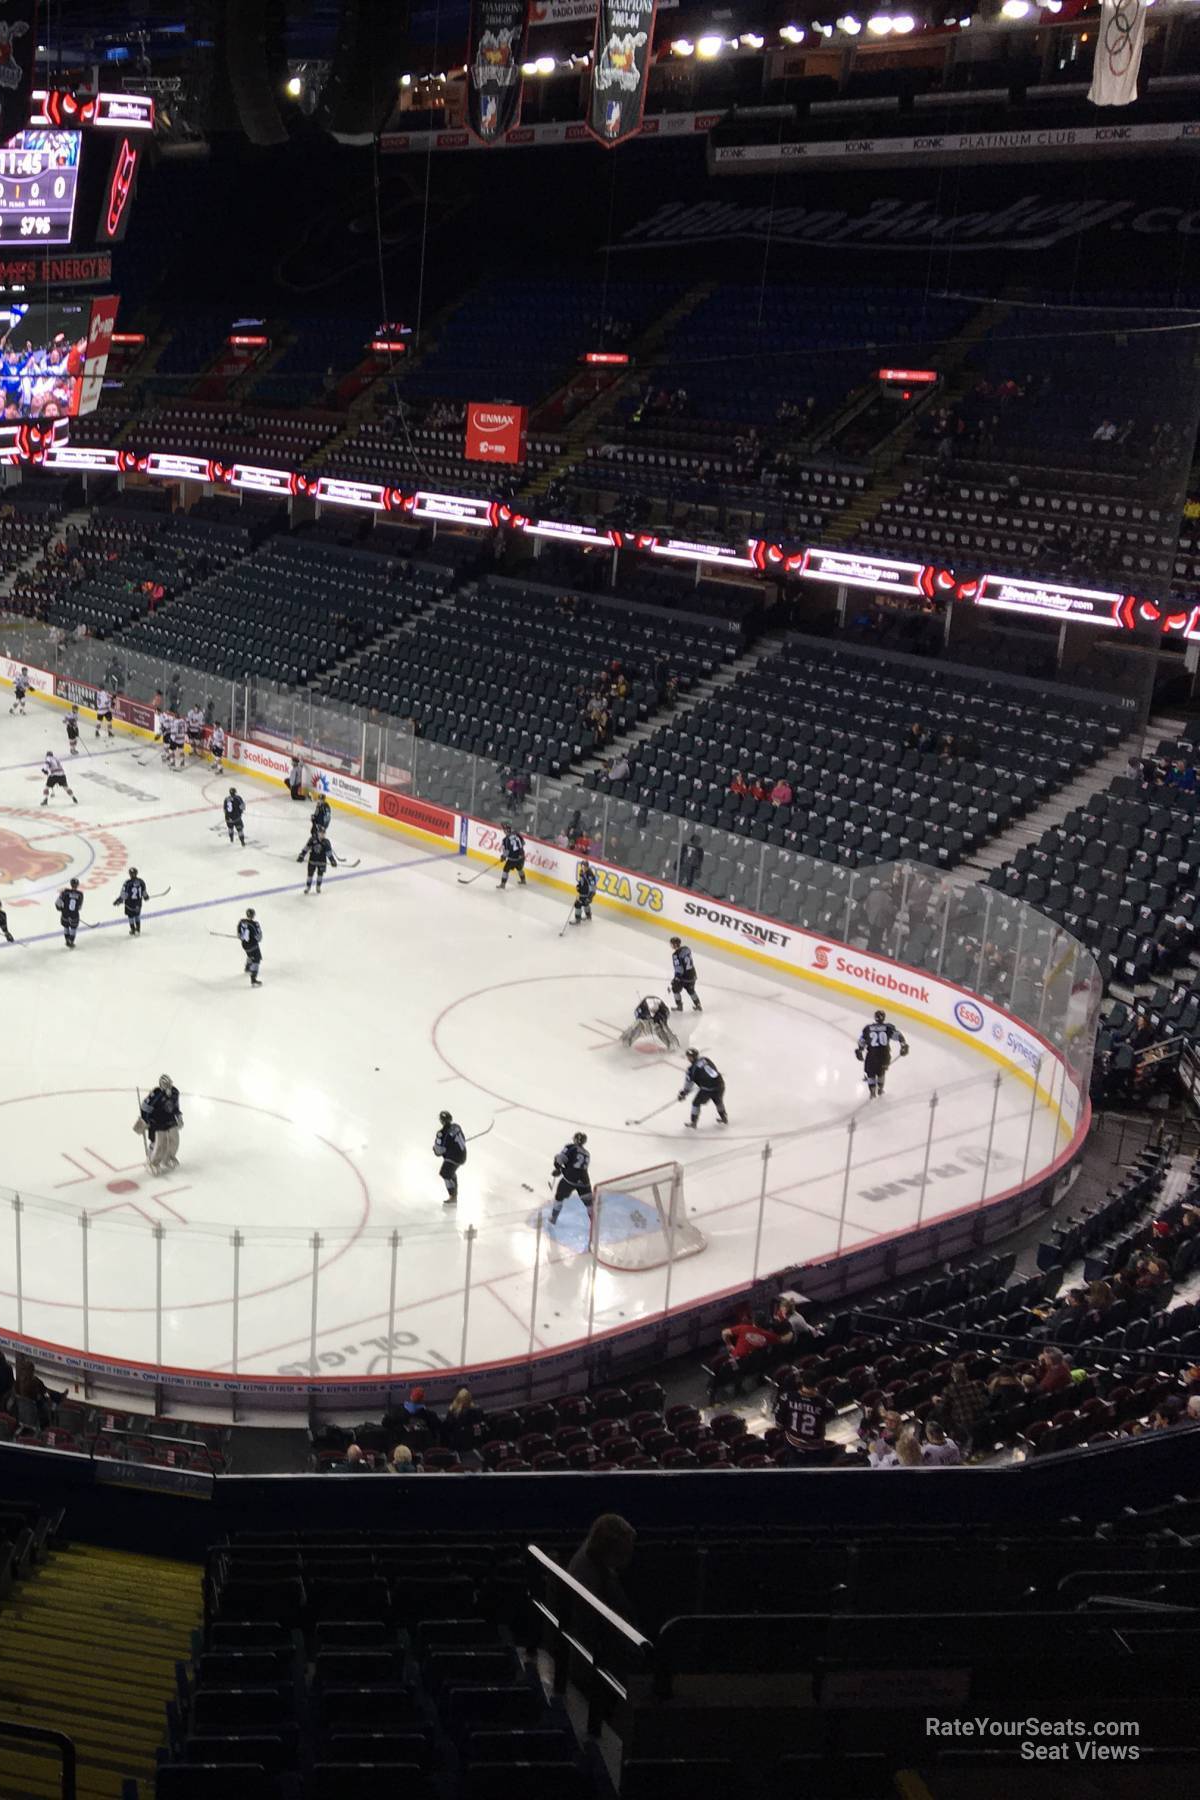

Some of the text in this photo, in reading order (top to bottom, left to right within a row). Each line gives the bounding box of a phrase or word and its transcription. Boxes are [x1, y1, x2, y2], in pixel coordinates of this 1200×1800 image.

[959, 131, 1077, 149] PLATINUM CLUB
[0, 153, 42, 175] 11:45
[30, 182, 40, 199] 0
[54, 176, 66, 199] 0
[42, 257, 97, 282] ENERGY
[480, 413, 515, 425] ENMAX
[243, 748, 290, 775] Scotiabank
[636, 882, 664, 912] 73
[683, 901, 792, 948] SPORTSNET
[836, 957, 931, 1004] Scotiabank
[958, 1004, 982, 1026] Esso
[790, 1411, 817, 1436] 12
